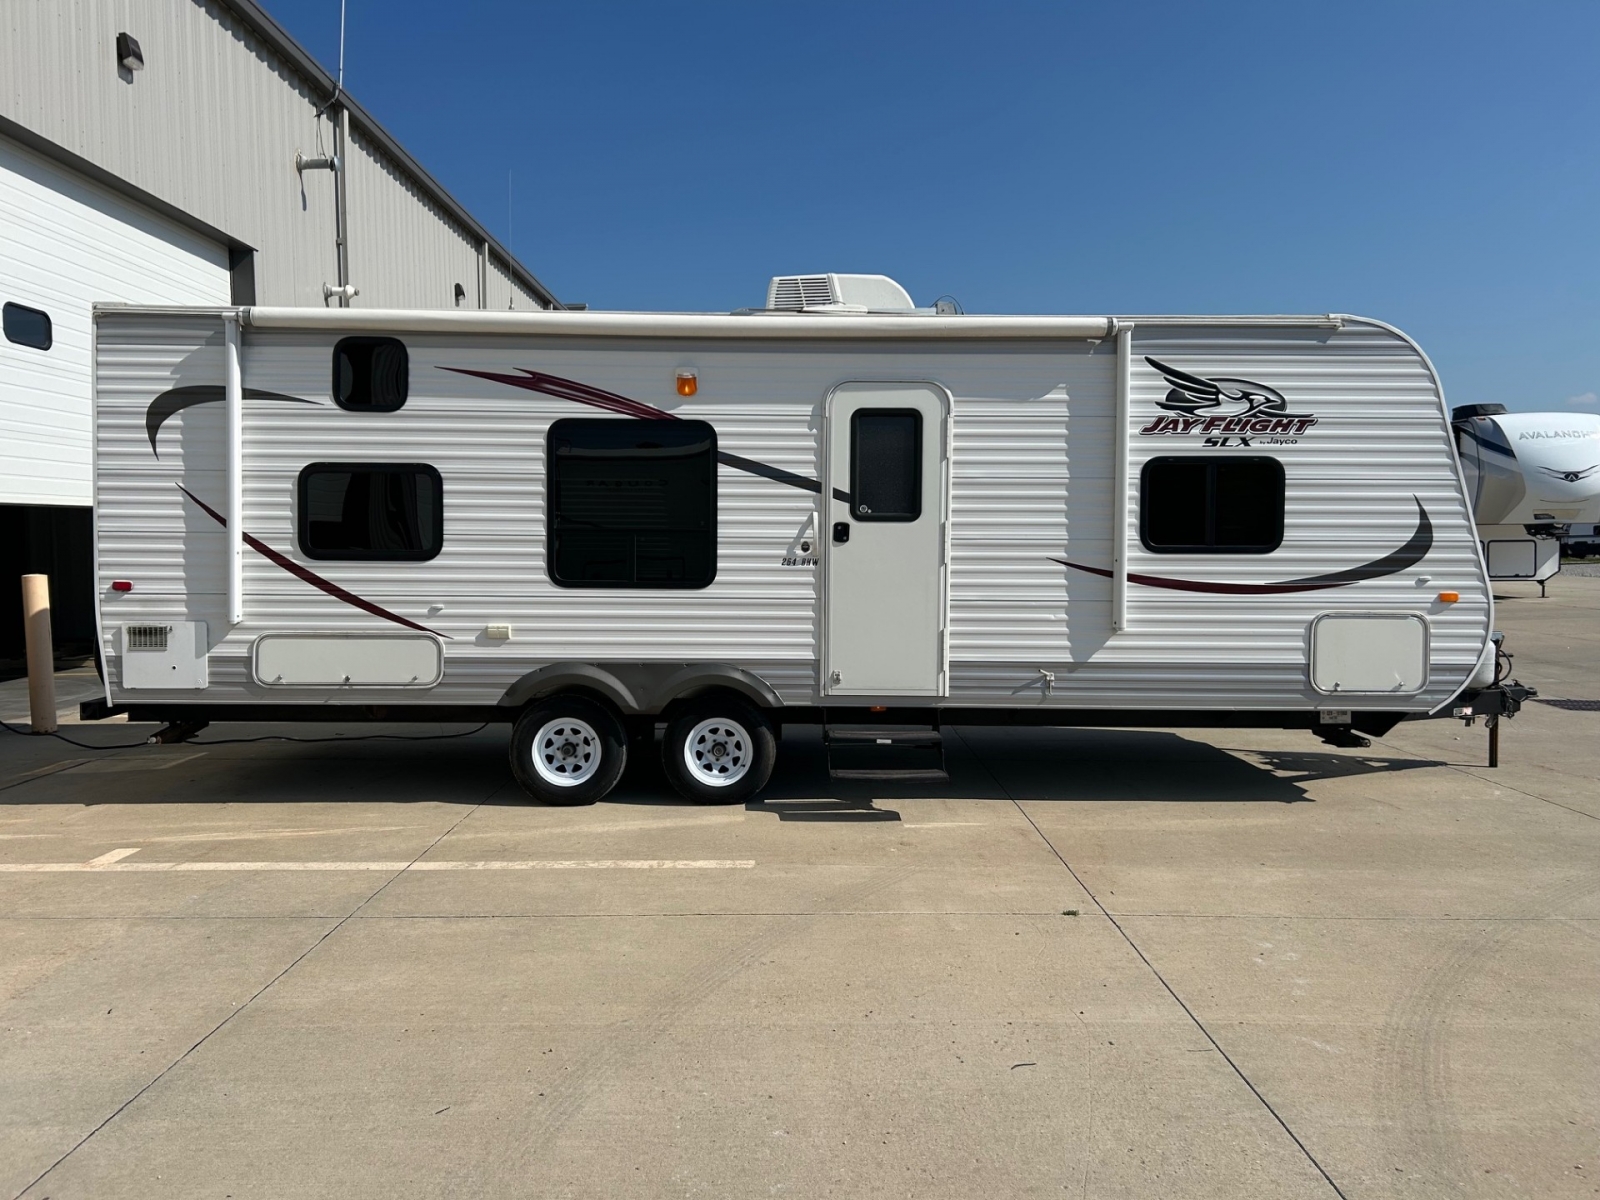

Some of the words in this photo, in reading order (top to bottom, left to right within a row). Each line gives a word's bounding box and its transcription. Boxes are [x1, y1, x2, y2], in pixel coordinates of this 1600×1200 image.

[1139, 415, 1202, 435] JAY
[1199, 415, 1318, 435] FLIGHT
[1202, 437, 1256, 447] SLX
[1267, 437, 1298, 446] Jayco
